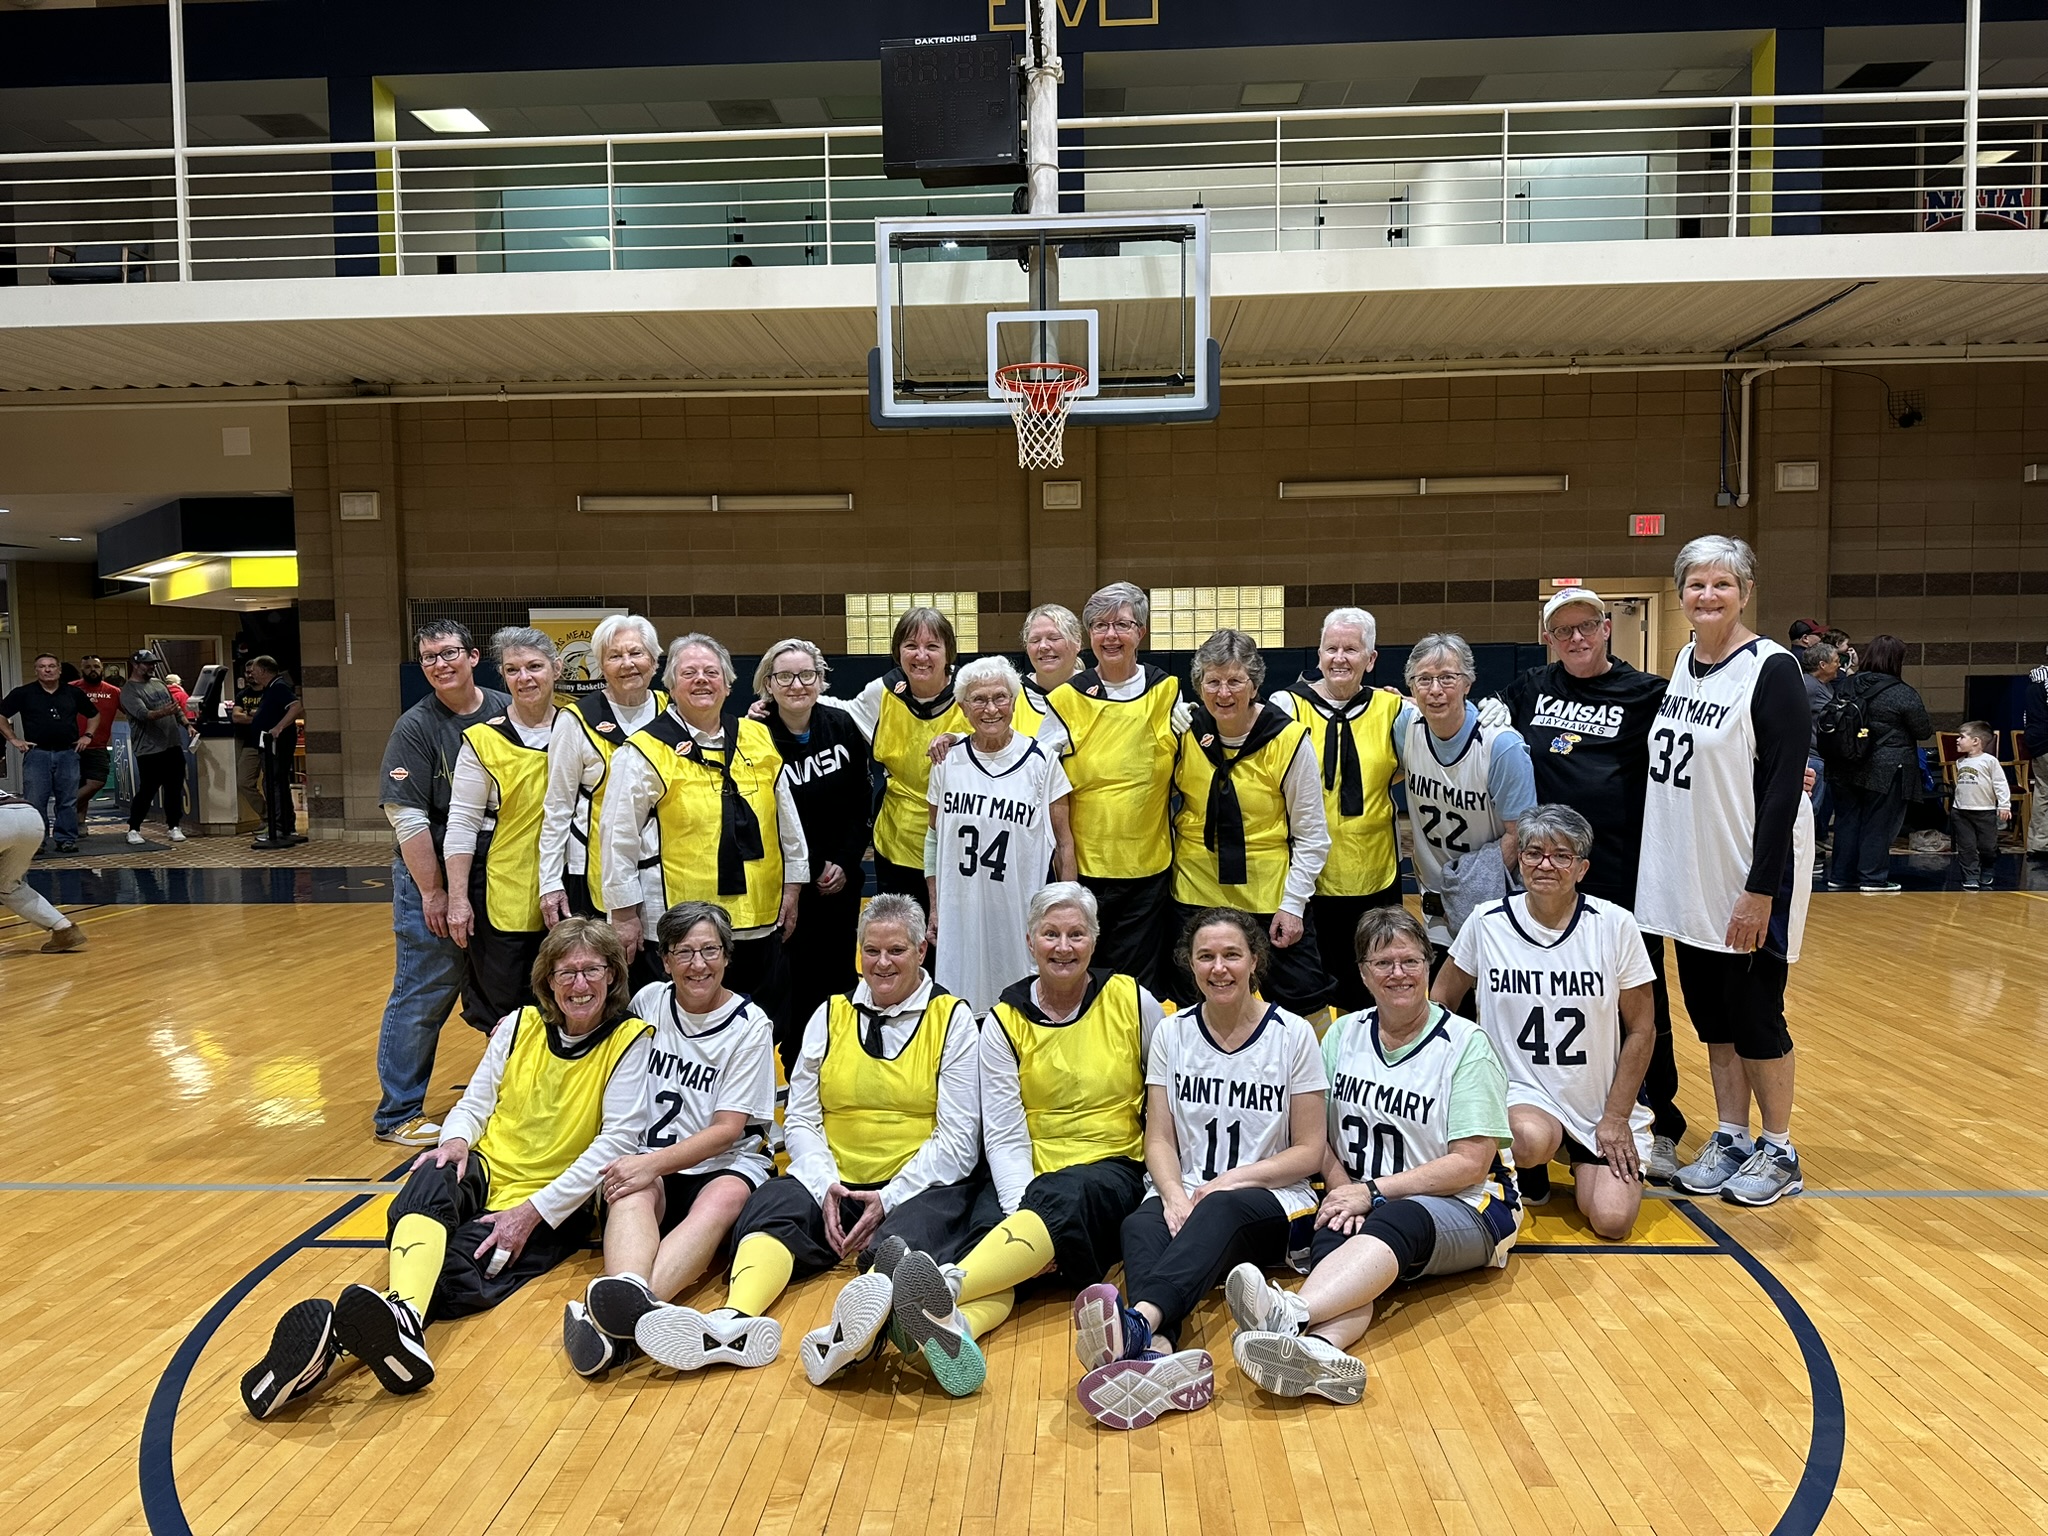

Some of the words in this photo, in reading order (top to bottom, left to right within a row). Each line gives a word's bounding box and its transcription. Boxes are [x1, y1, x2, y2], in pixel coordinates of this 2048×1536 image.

[914, 35, 977, 45] DAKTRONICS
[1636, 515, 1660, 535] EXIT
[566, 630, 592, 640] MEAD
[1534, 693, 1625, 727] KANSAS
[1539, 716, 1606, 735] JAYHAWKS
[1659, 694, 1688, 721] AINT
[1685, 698, 1731, 730] MARY
[781, 743, 851, 786] NASA
[1649, 727, 1695, 791] 32
[943, 791, 988, 816] SAINT
[988, 797, 1036, 828] MARY
[1407, 768, 1442, 800] AINT
[1443, 785, 1487, 811] MARY
[1418, 804, 1471, 853] 22
[957, 824, 1010, 882] 34
[1489, 968, 1544, 996] SAINT
[1550, 970, 1604, 997] MARY
[1516, 1006, 1587, 1066] 42
[648, 1047, 679, 1080] INT
[1174, 1072, 1225, 1106] SAINT
[1228, 1080, 1286, 1113] MARY
[1374, 1084, 1436, 1125] MARY
[646, 1089, 684, 1148] 2
[1202, 1117, 1241, 1181] 11
[1341, 1114, 1405, 1179] 30
